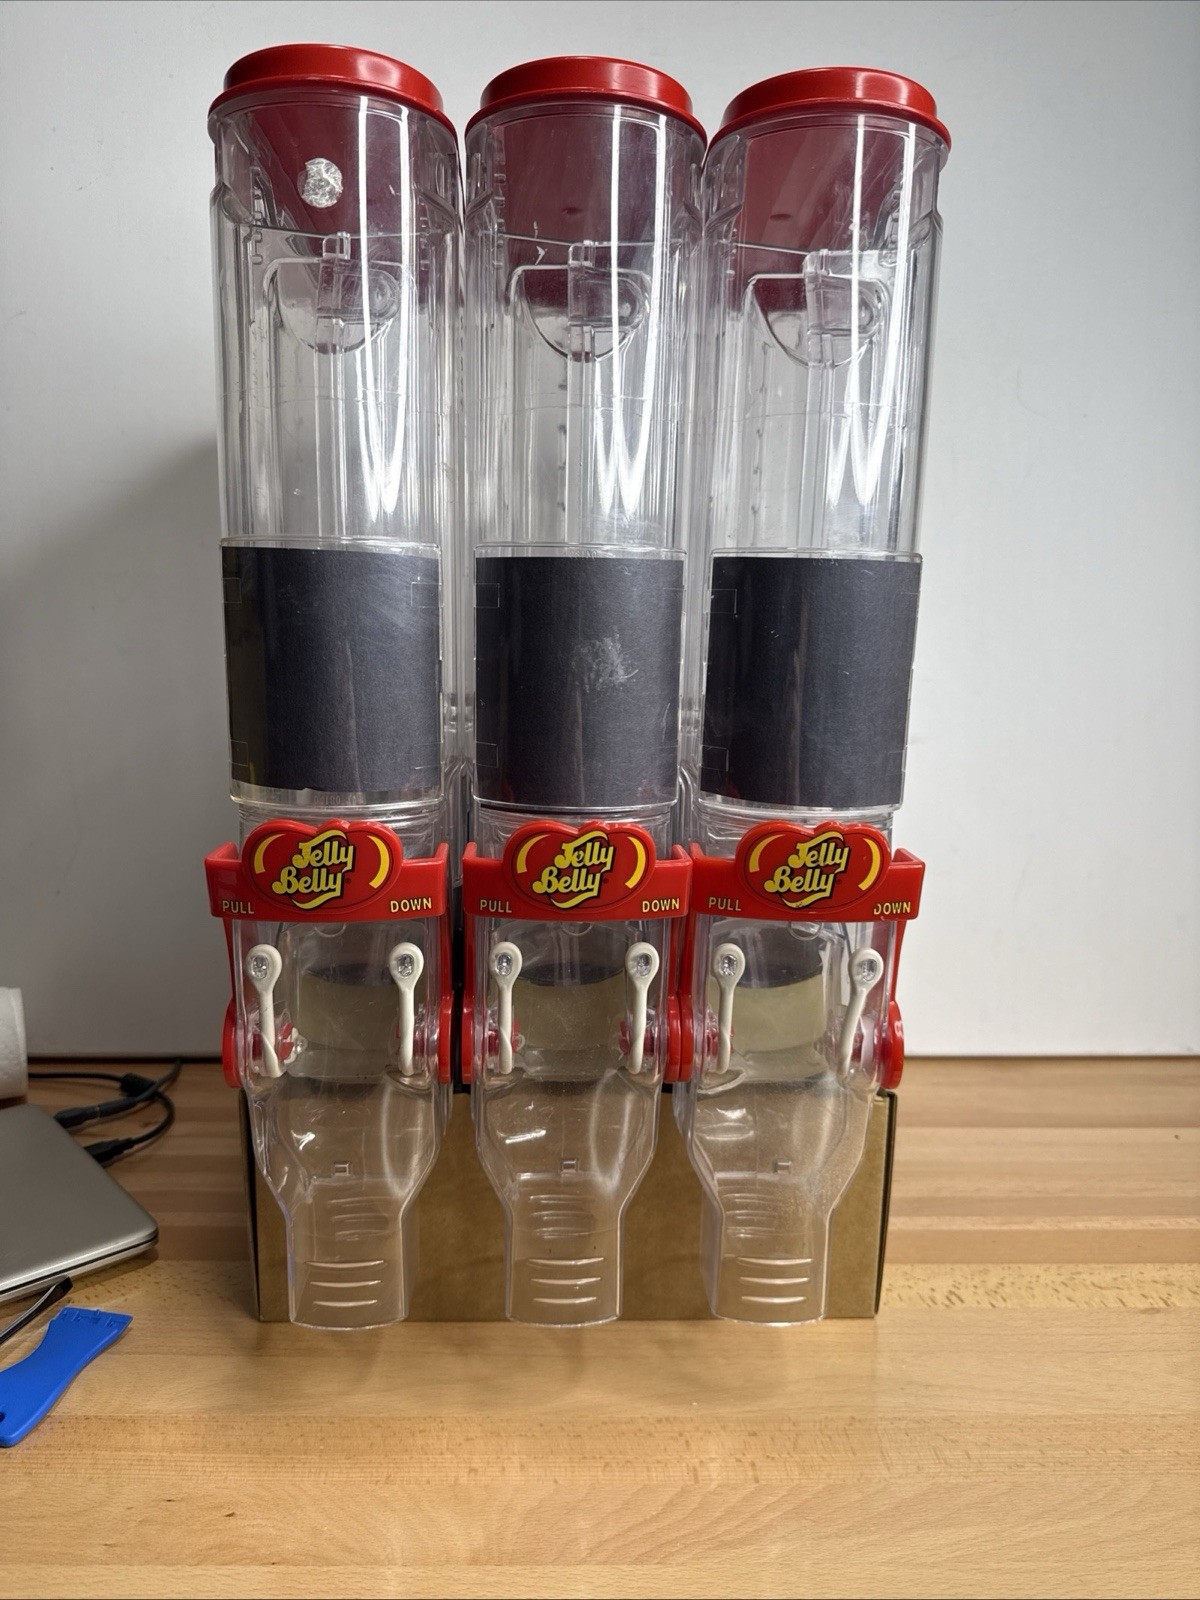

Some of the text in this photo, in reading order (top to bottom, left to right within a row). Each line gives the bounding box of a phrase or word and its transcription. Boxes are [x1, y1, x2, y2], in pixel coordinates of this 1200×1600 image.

[292, 830, 354, 872] Jelly
[554, 830, 615, 872] Jelly
[788, 831, 849, 873] Jelly
[222, 897, 432, 915] PULL DOWN
[272, 866, 342, 909] Belly
[480, 897, 680, 914] PULL DOWN
[532, 866, 602, 909] Belly
[708, 896, 742, 912] PULL
[764, 866, 835, 909] Belly
